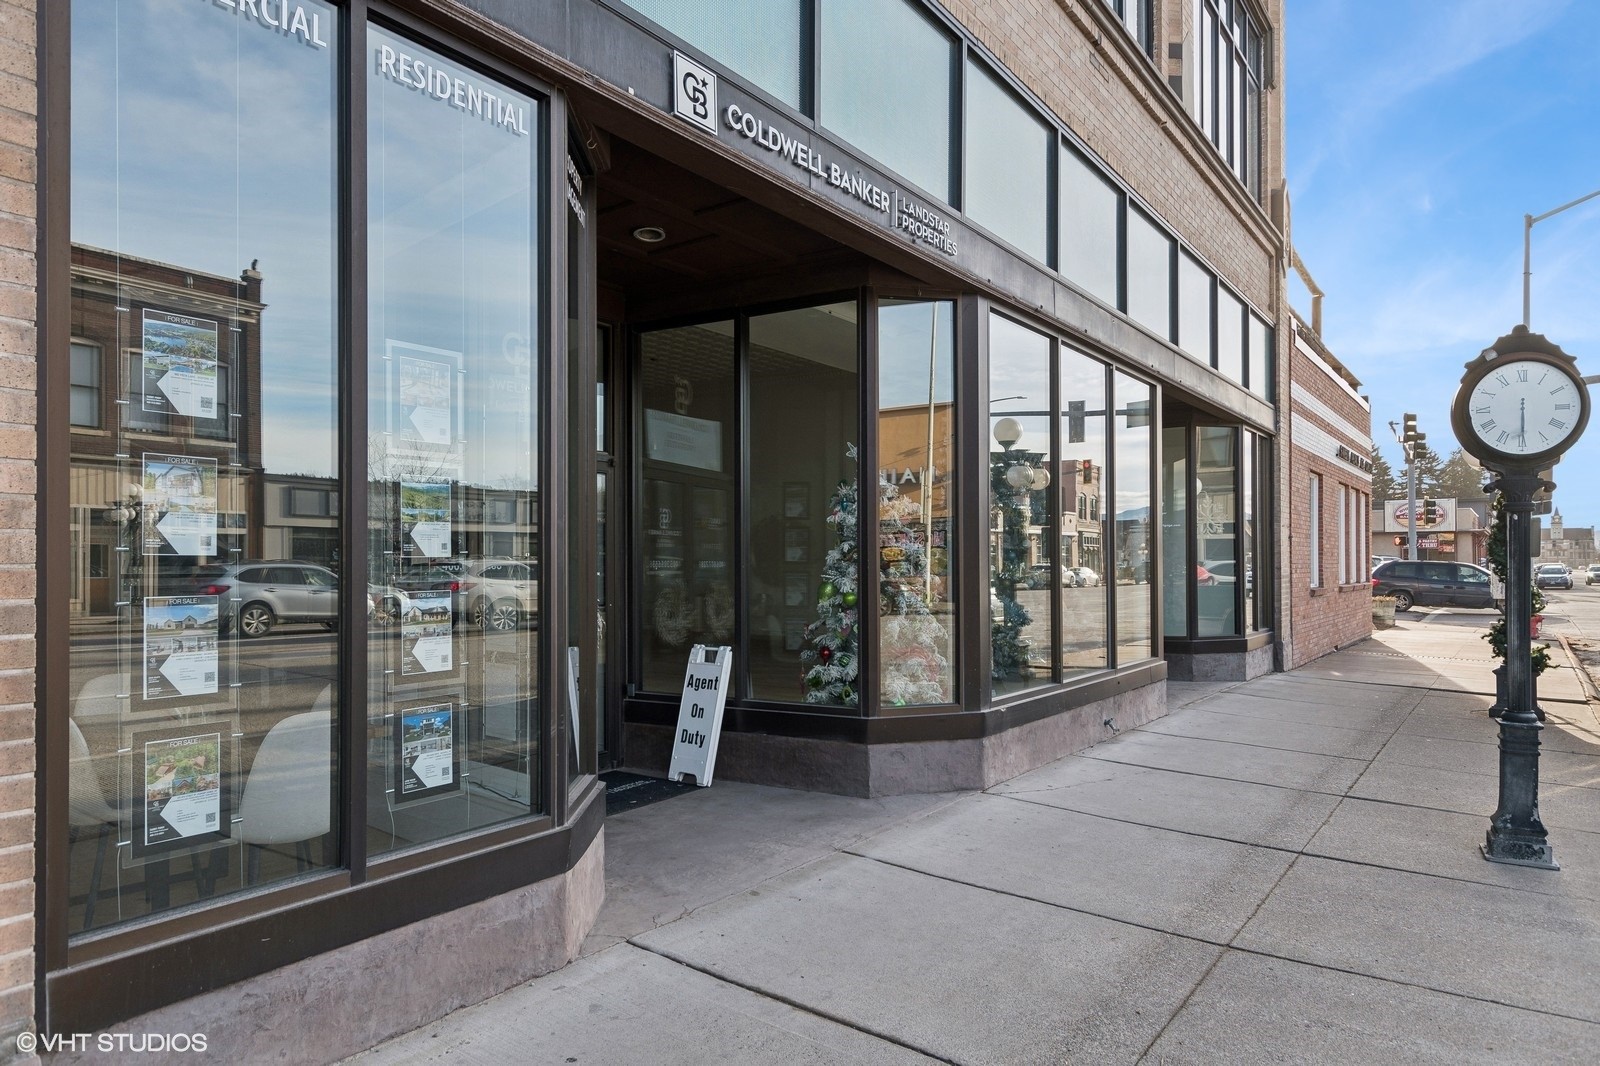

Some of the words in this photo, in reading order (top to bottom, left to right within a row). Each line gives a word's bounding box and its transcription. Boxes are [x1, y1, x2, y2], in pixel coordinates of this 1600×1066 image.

[221, 0, 327, 48] CIAL
[381, 44, 529, 136] RESIDENTIAL
[727, 104, 828, 179] COLDWELL
[831, 162, 890, 214] BANKER
[903, 197, 950, 236] LANDSTAR
[902, 214, 958, 256] PROPERTIES
[167, 315, 181, 323] FOR
[181, 318, 196, 326] SALE
[167, 456, 181, 464] FOR
[687, 674, 719, 692] Agent
[691, 703, 704, 719] On
[169, 740, 182, 748] FOR
[183, 737, 198, 745] SALE
[680, 729, 706, 748] Duty
